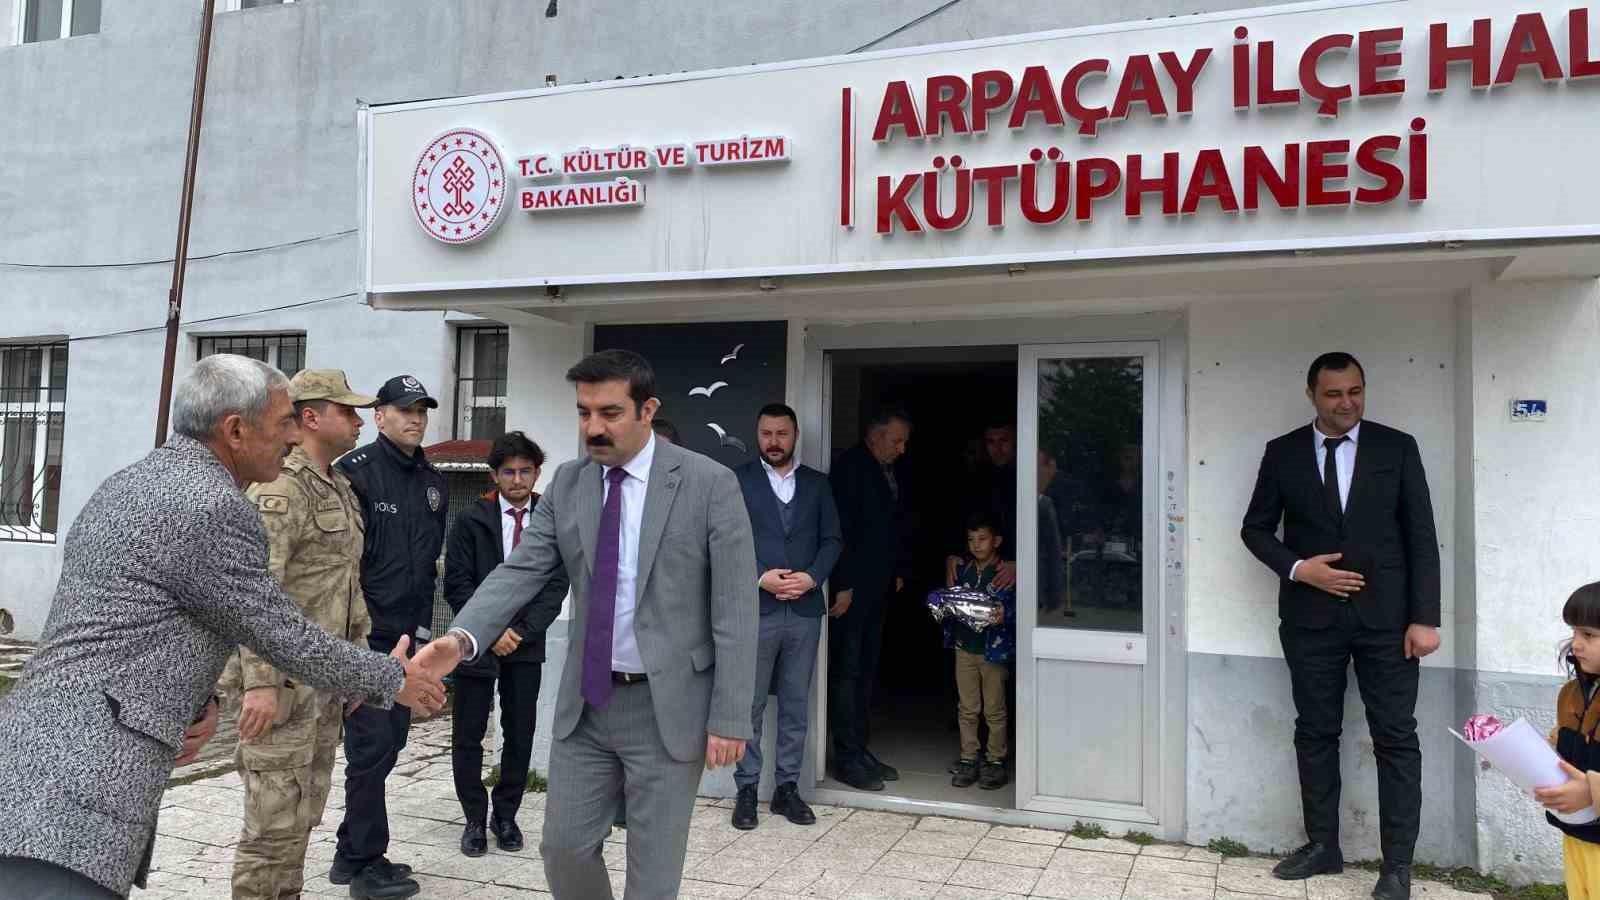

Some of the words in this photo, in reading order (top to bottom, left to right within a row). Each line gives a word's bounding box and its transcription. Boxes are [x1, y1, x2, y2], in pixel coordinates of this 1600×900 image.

[873, 47, 1213, 143] ARPAÇAY
[1233, 26, 1406, 119] İLÇE
[519, 157, 553, 177] T.C.
[563, 149, 648, 174] KÜLTÜR
[657, 146, 686, 167] VE
[696, 135, 785, 163] TURİZM
[522, 181, 638, 209] BAKANLIĞI
[875, 116, 1429, 235] KÜTÜPHANESİ
